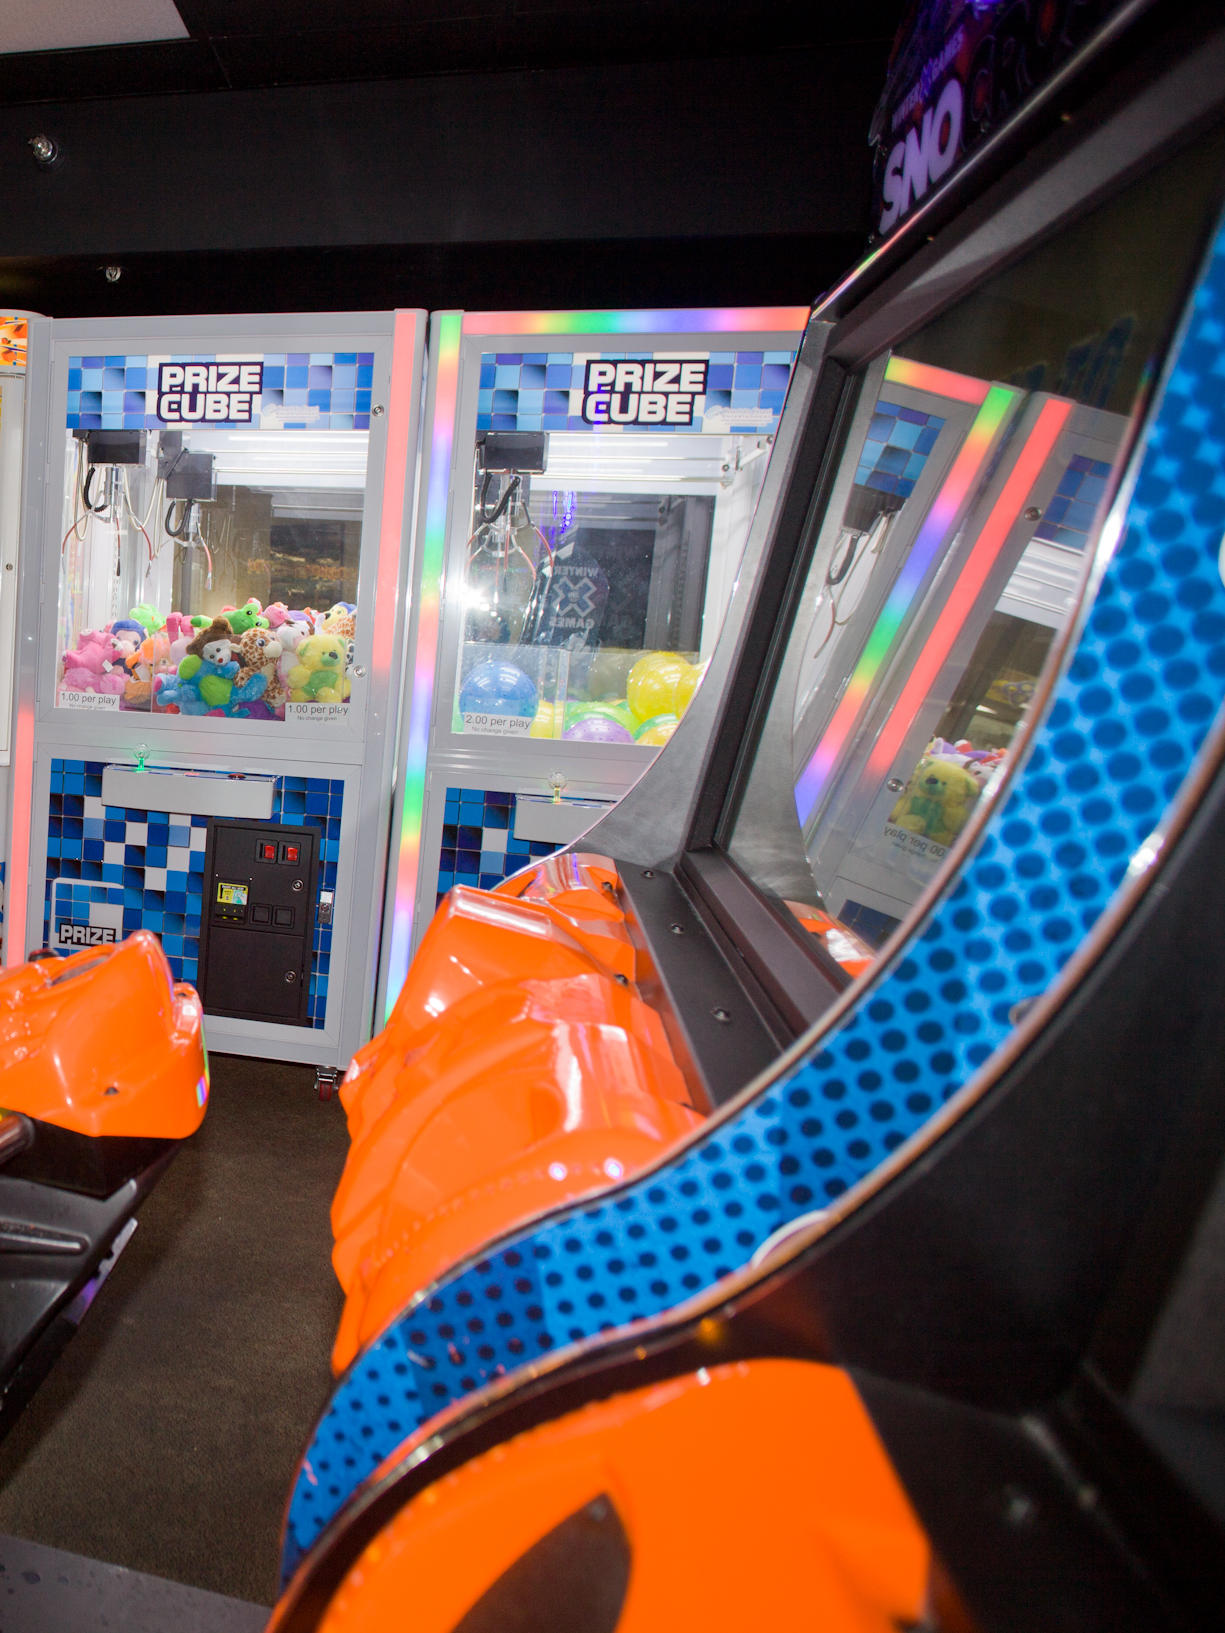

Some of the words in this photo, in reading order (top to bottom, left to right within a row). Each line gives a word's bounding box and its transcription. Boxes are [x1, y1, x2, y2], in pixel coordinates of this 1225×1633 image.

[161, 365, 261, 392] PRIZE
[588, 363, 705, 392] PRIZE
[160, 393, 252, 420] CUBE
[585, 394, 692, 423] CUBE
[62, 693, 79, 701] 1.00
[98, 696, 116, 705] play
[288, 705, 307, 713] 1.00
[311, 707, 326, 715] per
[329, 706, 348, 716] play
[466, 715, 487, 724] 2.00
[510, 719, 530, 729] play
[60, 926, 116, 944] PRIZE
